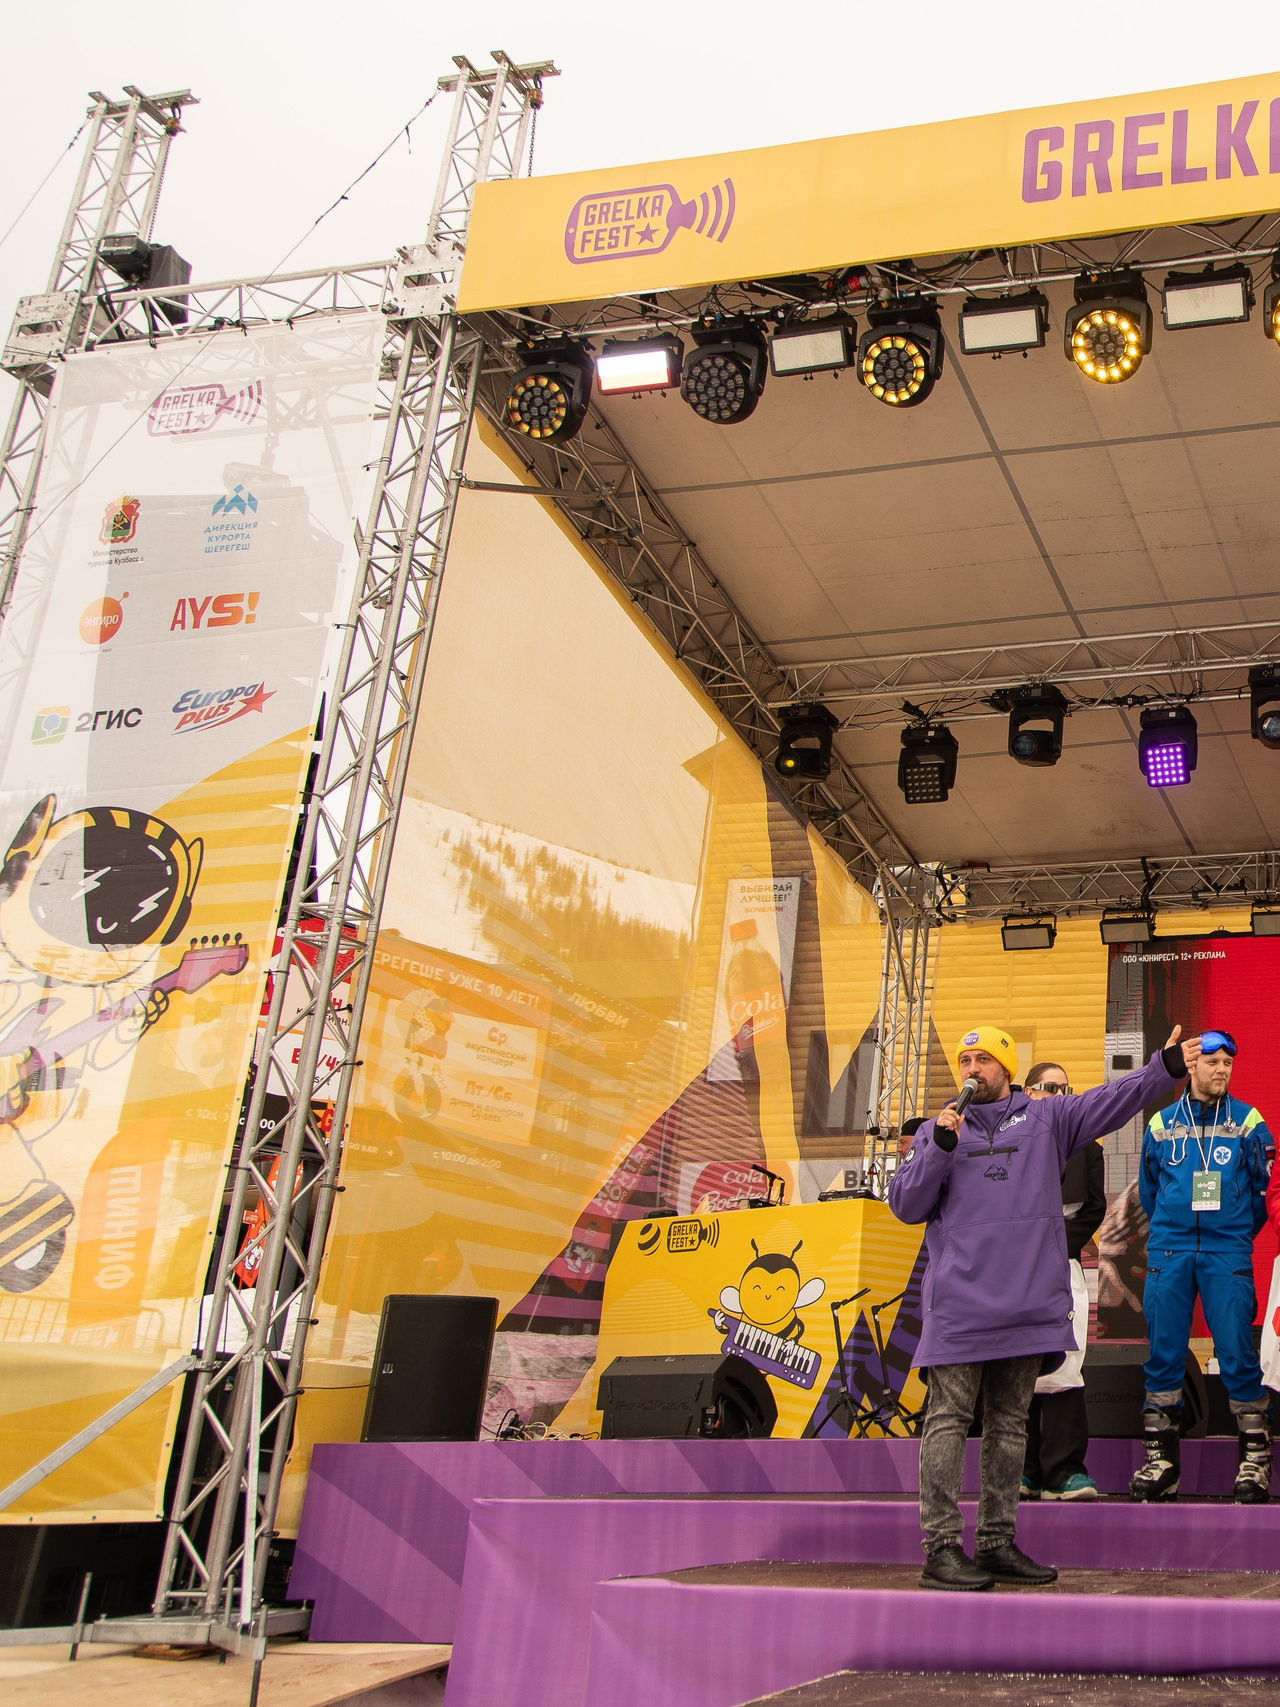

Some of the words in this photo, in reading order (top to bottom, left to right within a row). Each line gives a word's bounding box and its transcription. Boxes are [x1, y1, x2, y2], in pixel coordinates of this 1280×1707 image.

[583, 194, 664, 226] GRELKA
[580, 224, 635, 253] FEST
[162, 390, 216, 412] GRELKA
[157, 410, 194, 429] FEST
[204, 521, 258, 534] ДИРЕКЦИЯ
[207, 533, 251, 543] КУРОРТА
[92, 547, 138, 557] Министерство
[204, 543, 251, 553] ШЕРЕГЕШ
[170, 592, 260, 631] AYS!
[172, 683, 260, 713] Europa
[75, 708, 143, 732] 2ГИС
[740, 882, 793, 893] ВЫБИРАЙ
[1123, 955, 1137, 963] ООО
[1193, 951, 1226, 960] РЕКЛАМА
[374, 950, 444, 982] ЕРЕГЕШЕ
[449, 971, 483, 993] УЖЕ
[488, 983, 503, 998] 10
[506, 990, 540, 1008] ЛЕТ!
[730, 991, 789, 1023] Cola
[465, 1041, 527, 1063] акустический
[476, 1053, 515, 1068] концерт
[449, 1097, 475, 1109] днем
[485, 1104, 524, 1118] вечером
[361, 1144, 379, 1154] BAR
[441, 1150, 466, 1163] 10:00
[722, 1169, 763, 1184] Cola
[94, 1166, 142, 1290] ФИНИШ
[673, 1223, 698, 1237] GRELKA
[671, 1236, 690, 1249] FEST
